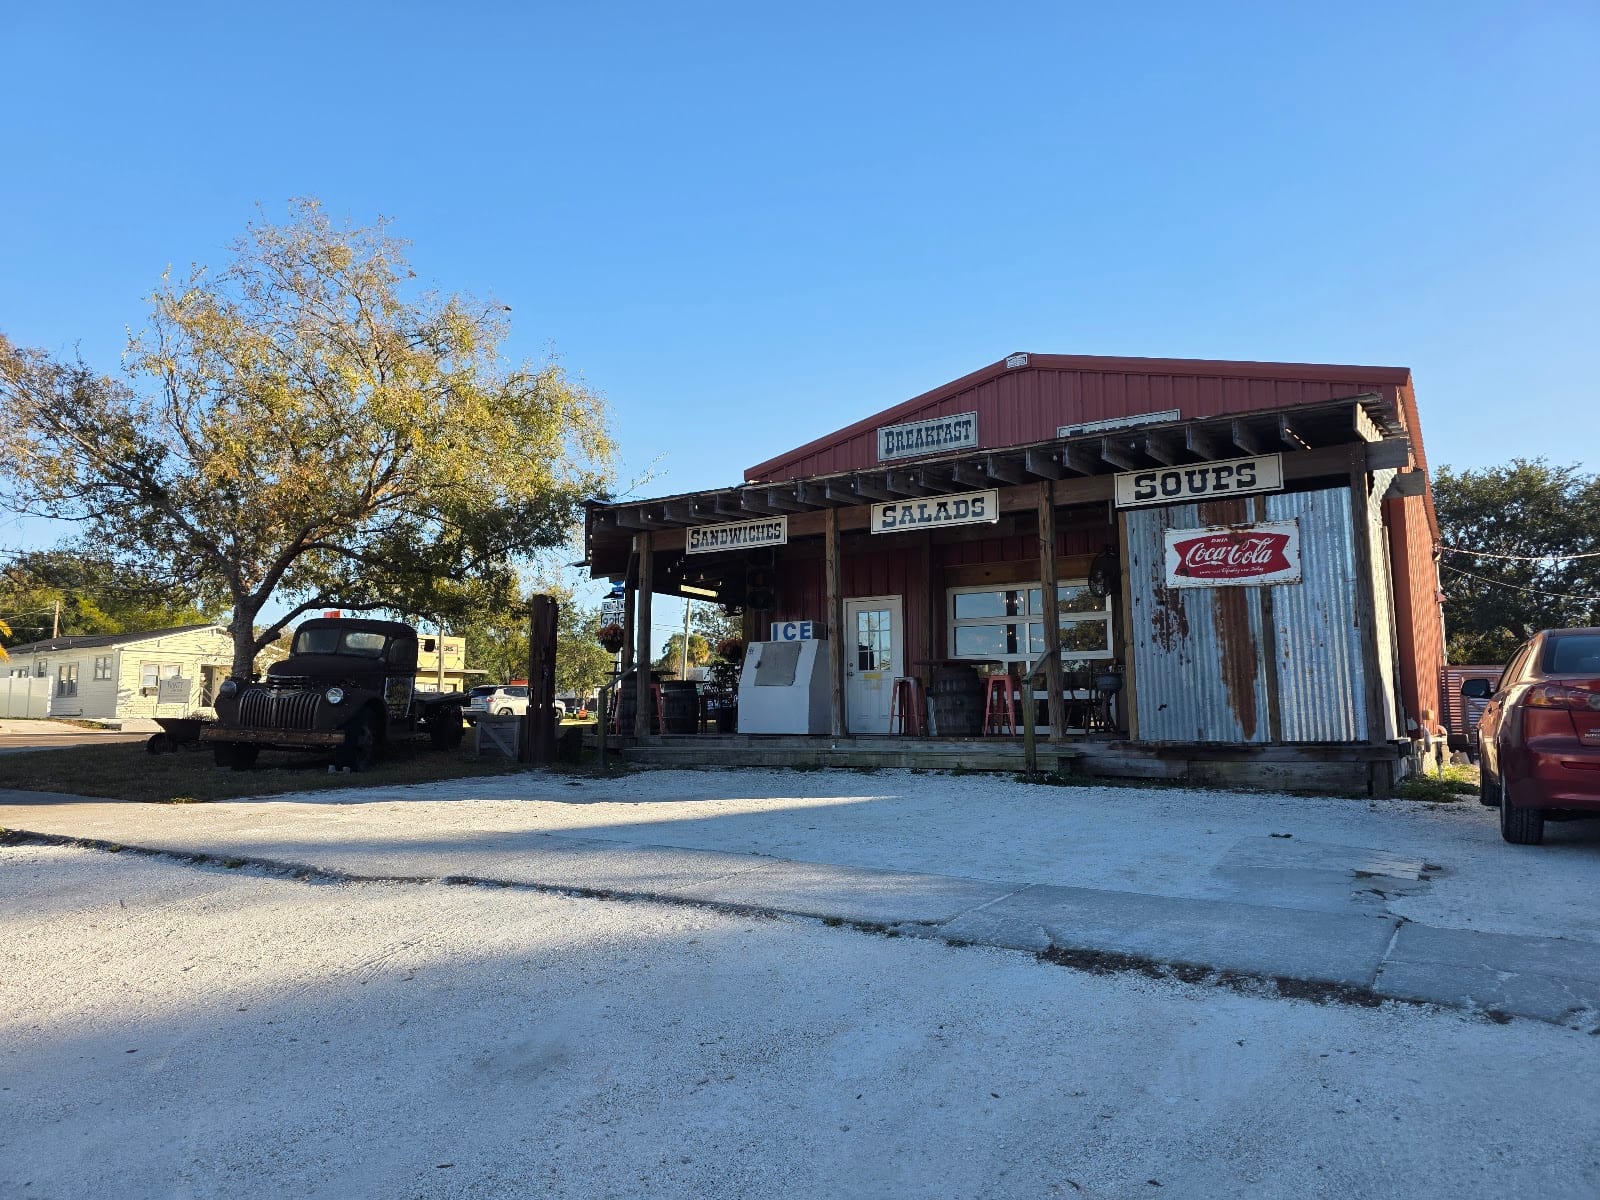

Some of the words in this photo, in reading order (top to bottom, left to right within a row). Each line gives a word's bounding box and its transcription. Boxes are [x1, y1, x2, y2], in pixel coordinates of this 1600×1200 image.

[884, 419, 972, 454] BREAKFAST
[1134, 462, 1257, 500] SOUPS
[881, 497, 985, 529] SALADS
[690, 522, 782, 549] SANDWICHES
[772, 622, 811, 641] ICE
